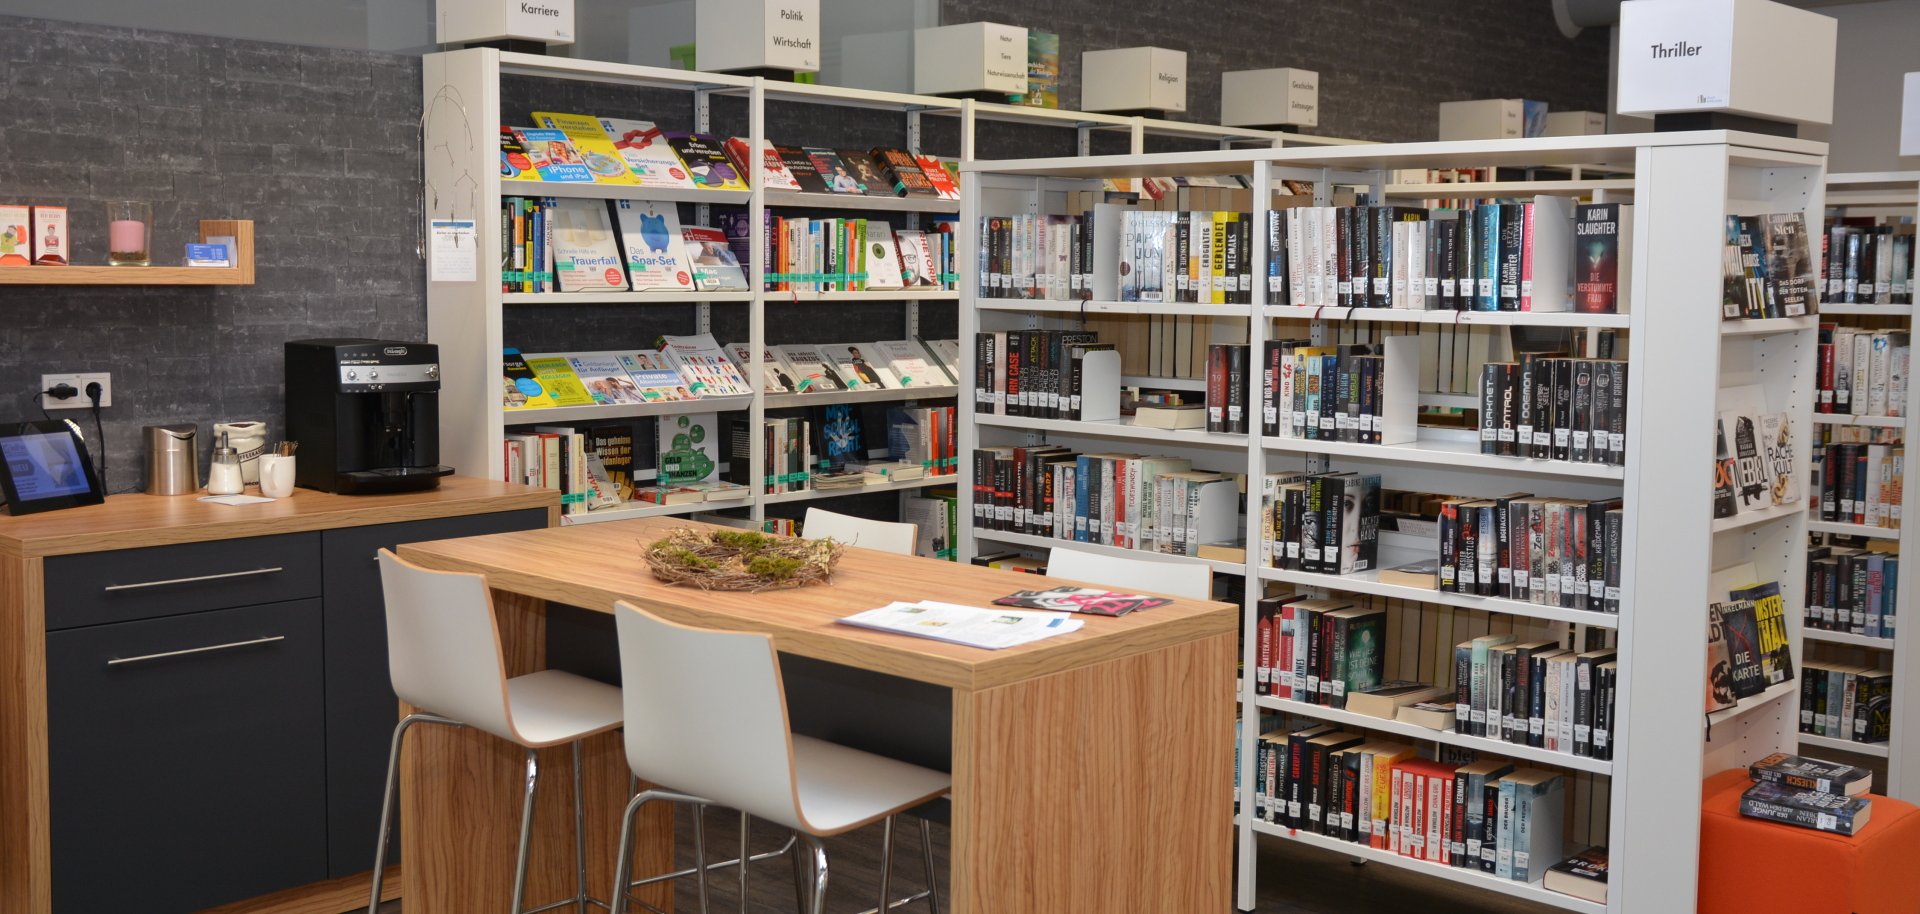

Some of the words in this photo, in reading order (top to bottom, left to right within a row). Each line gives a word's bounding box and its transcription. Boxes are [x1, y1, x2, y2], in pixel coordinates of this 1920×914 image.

[521, 2, 559, 17] Karriere
[781, 9, 804, 21] Politik
[773, 36, 812, 49] Wirtschaft
[1000, 35, 1012, 43] Natur
[1651, 41, 1702, 59] Thriller
[987, 69, 1025, 79] Naturwissenschaft
[1159, 72, 1179, 84] Religion
[1292, 80, 1314, 91] Geschichte
[548, 165, 585, 174] iPhone
[1404, 213, 1420, 222] KARIN
[1587, 208, 1608, 222] KARIN
[1577, 222, 1616, 235] SLAUGHTER
[1774, 225, 1794, 234] Sten
[630, 246, 644, 255] Das
[1214, 221, 1223, 270] GEBLENDET
[1227, 234, 1236, 270] NIEMALS
[570, 256, 617, 265] Trauerfall
[631, 255, 677, 266] Spar-Set
[918, 231, 938, 286] RHETORIK
[1508, 253, 1517, 285] AUGHTER
[1590, 272, 1600, 282] DIE
[1577, 283, 1613, 293] VERSTUMMTE
[1790, 286, 1808, 294] TOTEN
[1587, 294, 1602, 303] FRAU
[1062, 335, 1097, 343] PRESTON
[1009, 352, 1019, 376] CASE
[1230, 374, 1240, 382] 17
[1264, 369, 1272, 386] SMITH
[1613, 370, 1622, 396] GERECHTE
[1264, 386, 1272, 399] ROB
[1350, 373, 1358, 403] MAGUS
[1522, 371, 1531, 419] DAEMON
[1486, 380, 1494, 430] ARKNET
[1503, 385, 1512, 430] ONTROL
[595, 438, 607, 446] Das
[607, 436, 632, 445] geheime
[596, 447, 619, 456] Wissen
[620, 446, 632, 454] der
[1768, 444, 1792, 462] RACHE
[12, 463, 29, 473] NEU
[1734, 456, 1767, 488] NEBEL
[1773, 460, 1792, 476] KULT
[1129, 467, 1137, 507] TODESWUNSCH
[1360, 528, 1376, 540] HAUS
[1466, 536, 1474, 572] EWUSSTLOS
[1722, 600, 1755, 614] INKELMANN
[1735, 651, 1751, 665] DIE
[1733, 664, 1760, 682] KARTE
[1786, 775, 1817, 789] KLIESCH
[1748, 800, 1769, 809] WALD
[1769, 804, 1782, 812] DEM
[1752, 807, 1776, 816] JUNGE
[1776, 811, 1788, 819] DER
